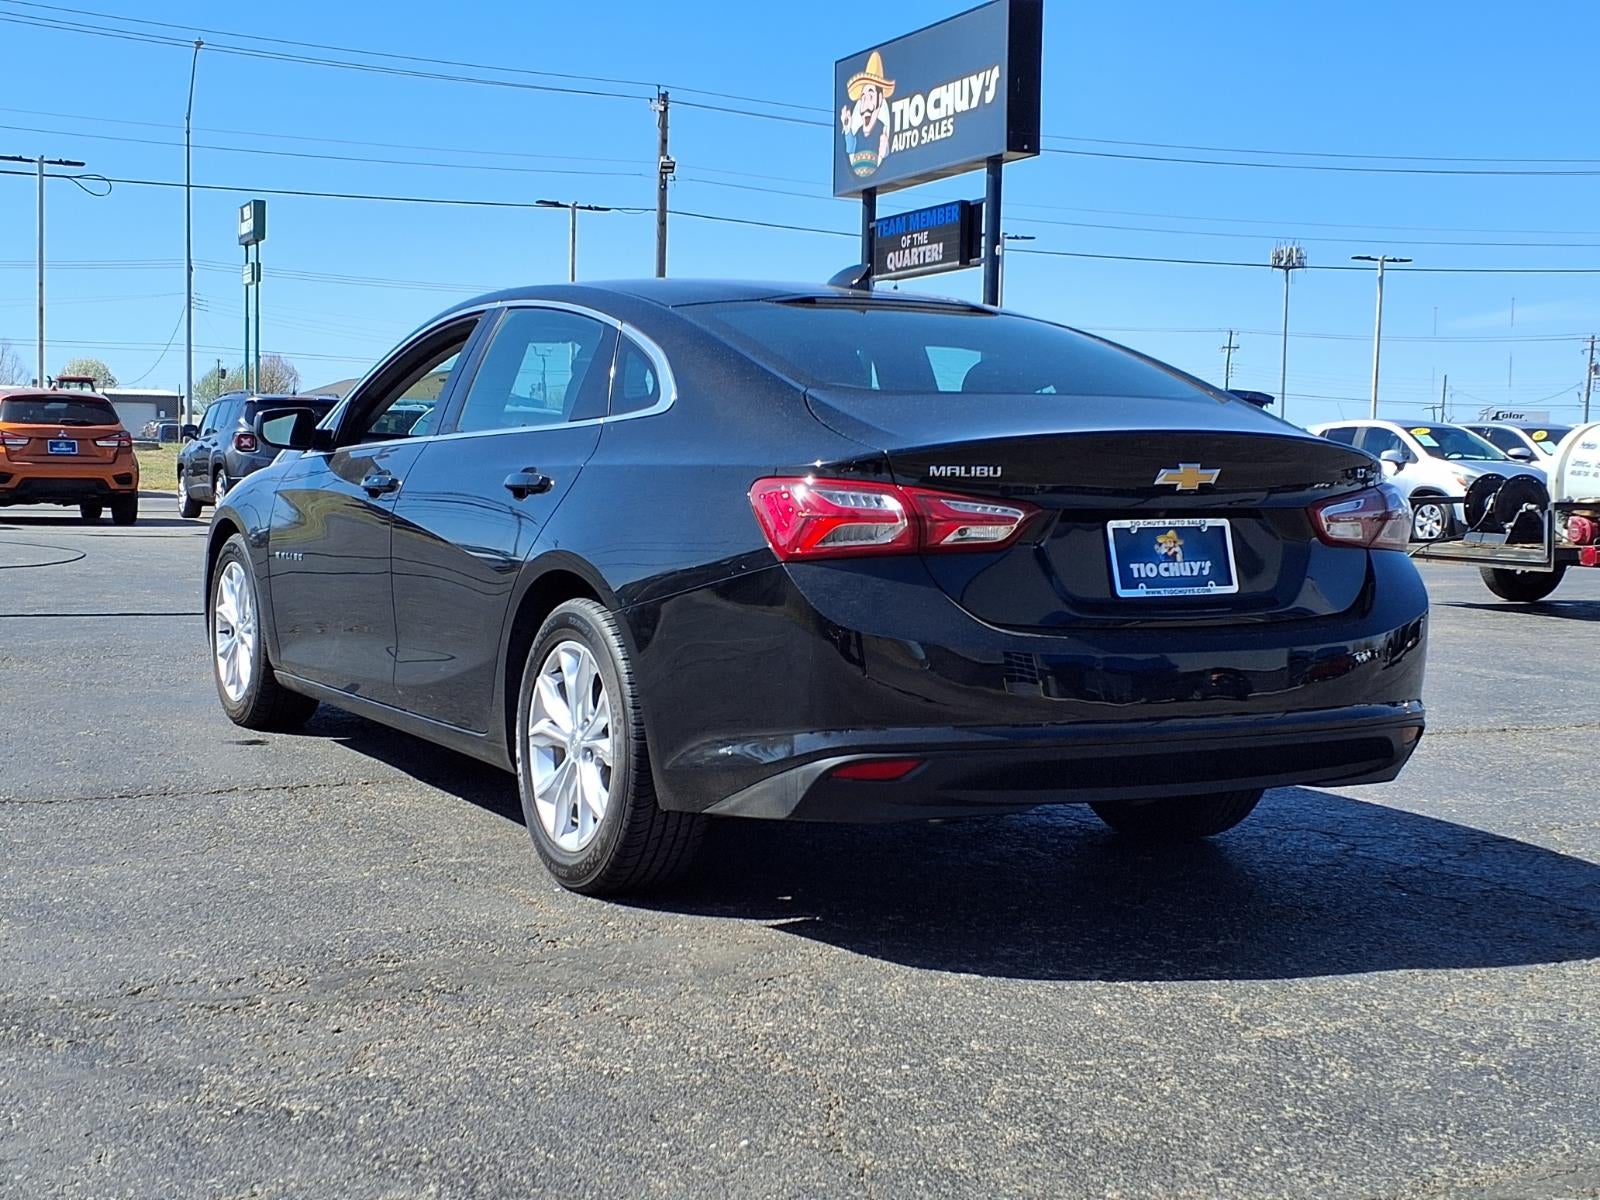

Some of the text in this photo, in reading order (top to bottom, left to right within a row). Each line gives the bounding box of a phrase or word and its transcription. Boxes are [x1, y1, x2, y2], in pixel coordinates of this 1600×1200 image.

[891, 65, 1000, 132] TIO CHUY'S
[891, 117, 954, 152] AUTO SALES
[876, 204, 959, 238] TEAM MEMBER
[901, 231, 929, 249] OF THE
[887, 242, 943, 271] QUARTER!
[929, 465, 1002, 478] MALIBU
[1130, 560, 1212, 578] TIO CHUY'S
